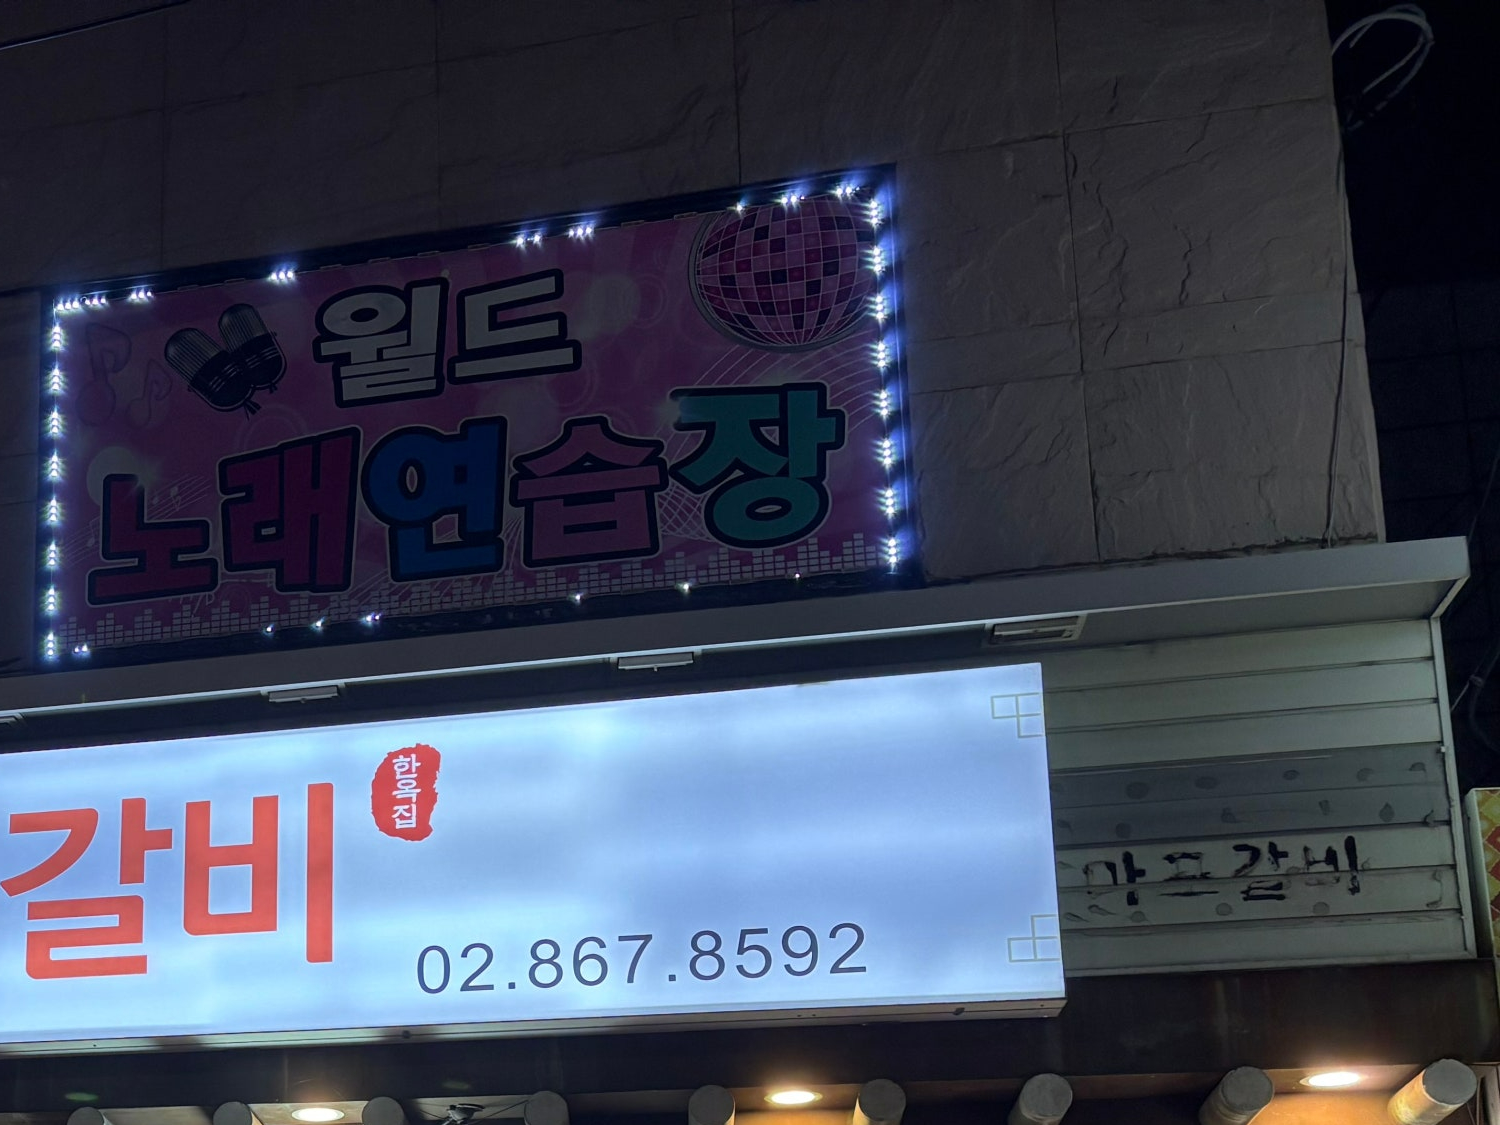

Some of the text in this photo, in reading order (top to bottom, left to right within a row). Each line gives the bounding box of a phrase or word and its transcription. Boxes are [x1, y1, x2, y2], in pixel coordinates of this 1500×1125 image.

[312, 267, 581, 408] 월드
[88, 382, 846, 606] 노래연습장
[392, 754, 421, 829] 한옥집
[417, 921, 868, 996] 02.867.8592
